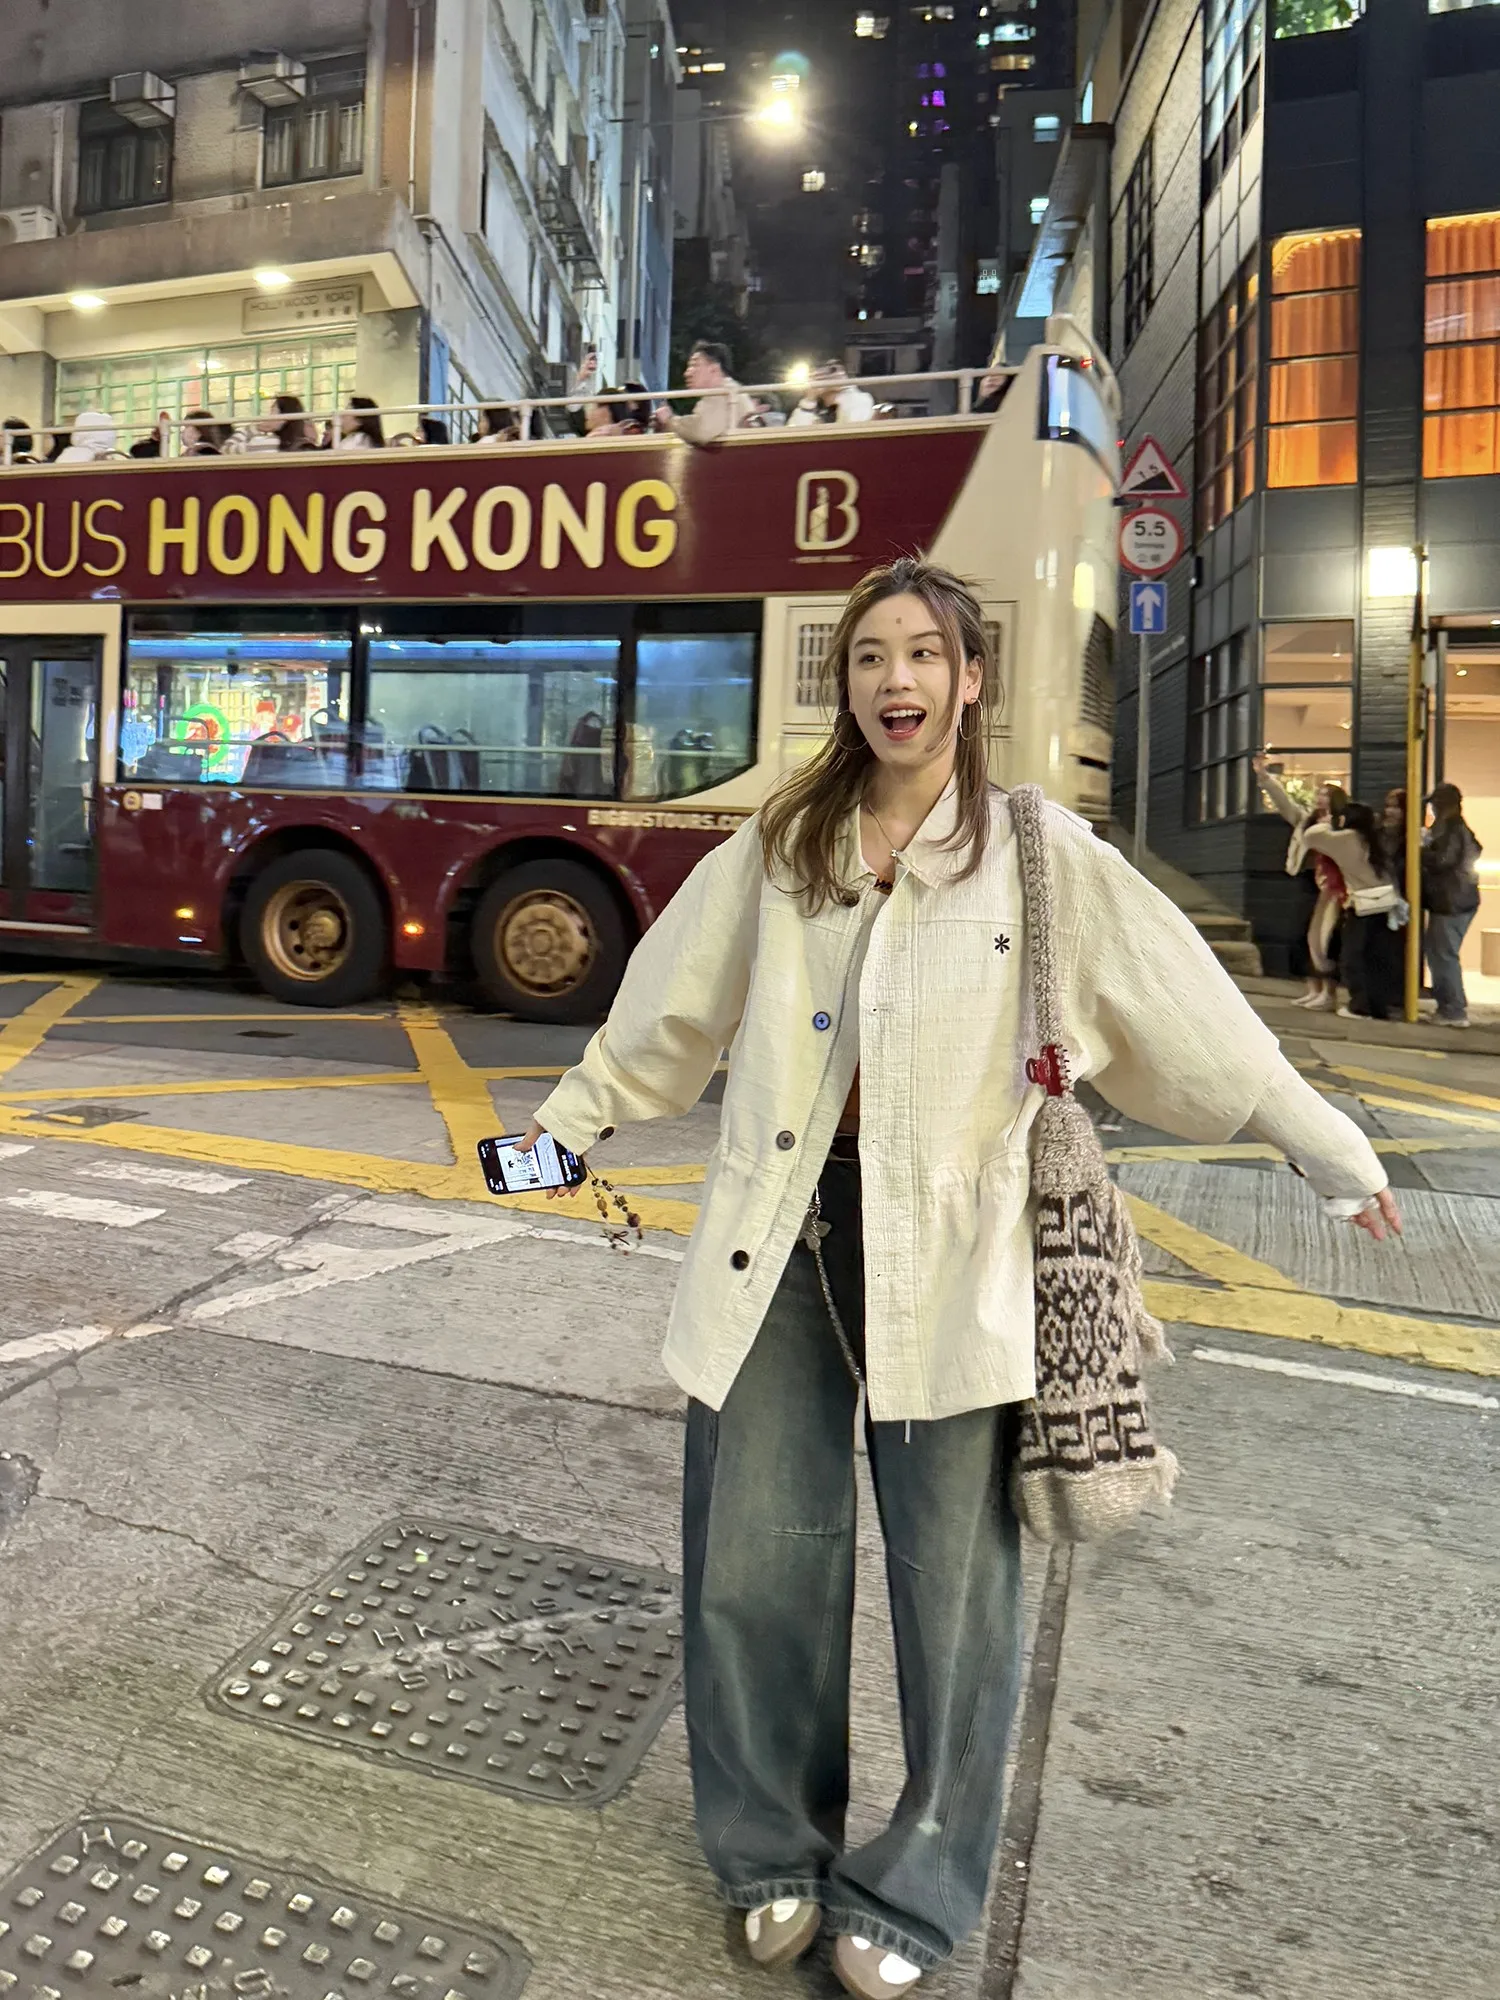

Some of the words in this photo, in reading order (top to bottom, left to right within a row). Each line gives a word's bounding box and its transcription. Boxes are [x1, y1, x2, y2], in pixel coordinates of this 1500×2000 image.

[0, 499, 128, 577] BUS
[149, 490, 388, 575] HONG
[411, 479, 679, 572] KONG
[1134, 520, 1166, 537] 5.5
